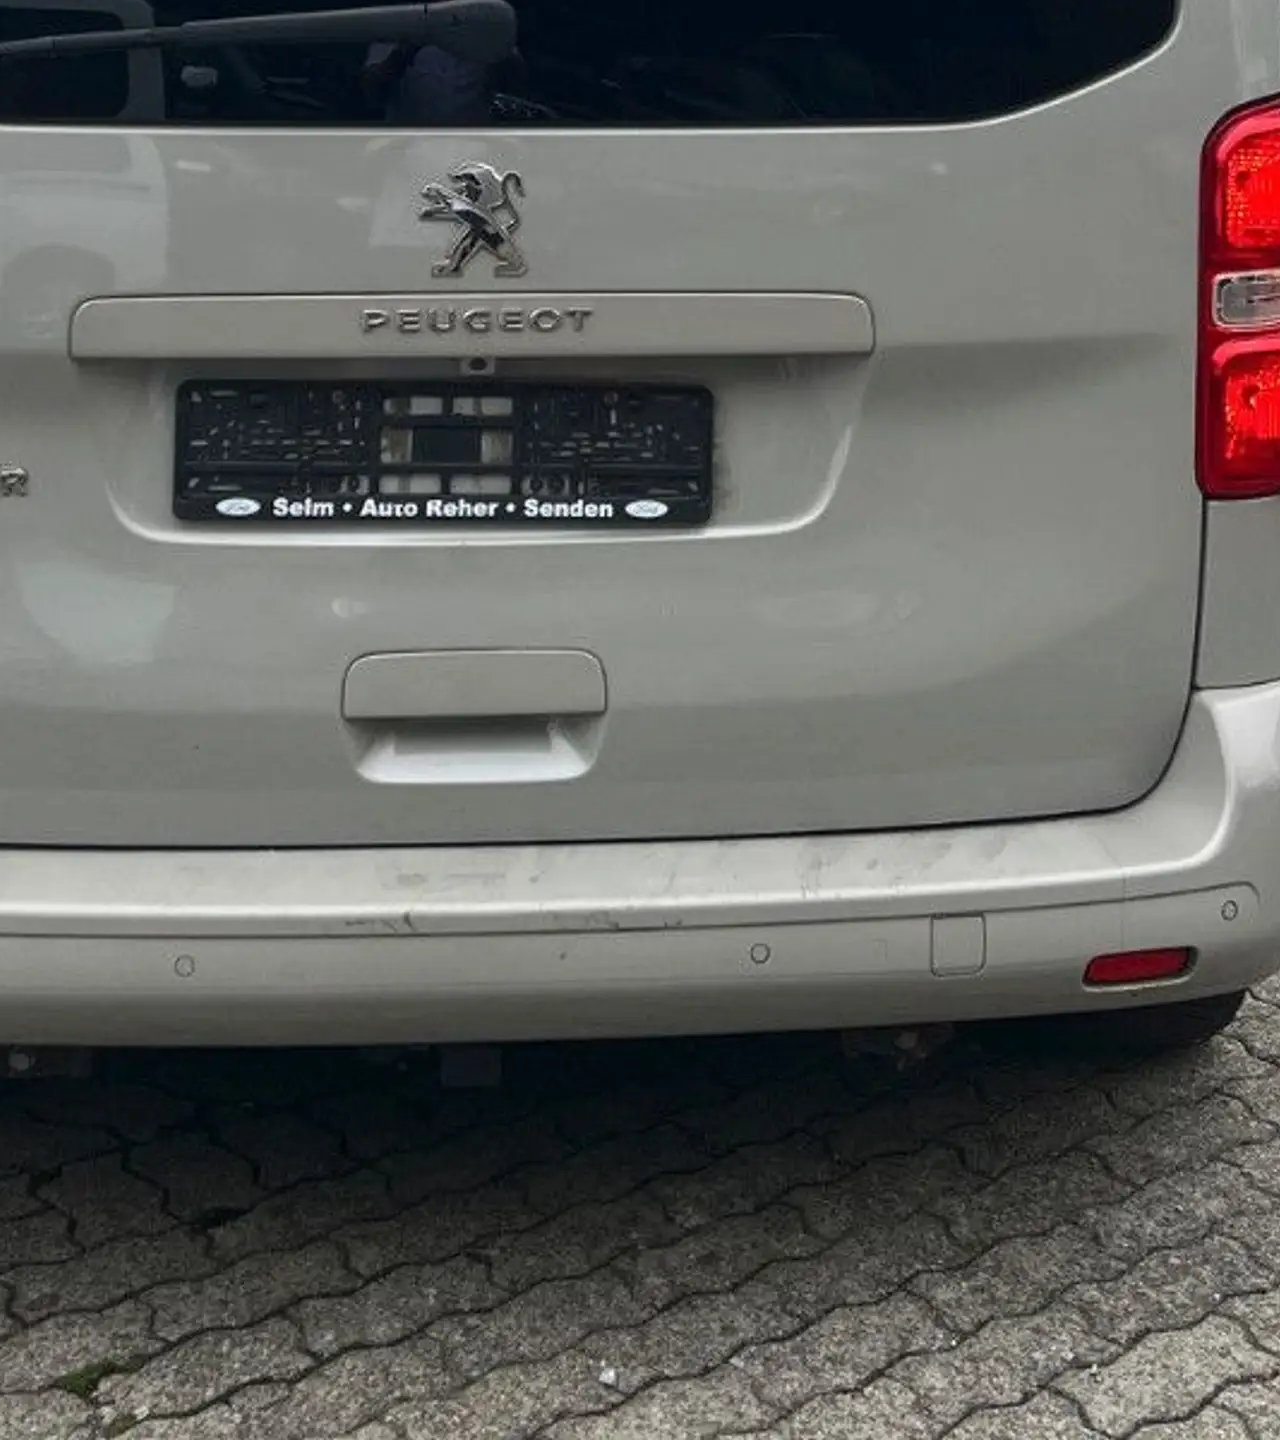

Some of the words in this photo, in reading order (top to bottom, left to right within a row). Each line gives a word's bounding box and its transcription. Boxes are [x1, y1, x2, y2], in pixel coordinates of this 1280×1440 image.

[362, 308, 593, 333] PEUGEOT
[272, 496, 334, 518] Selm
[359, 498, 419, 518] Auto
[425, 498, 500, 518] Reher
[523, 497, 614, 519] Senden
